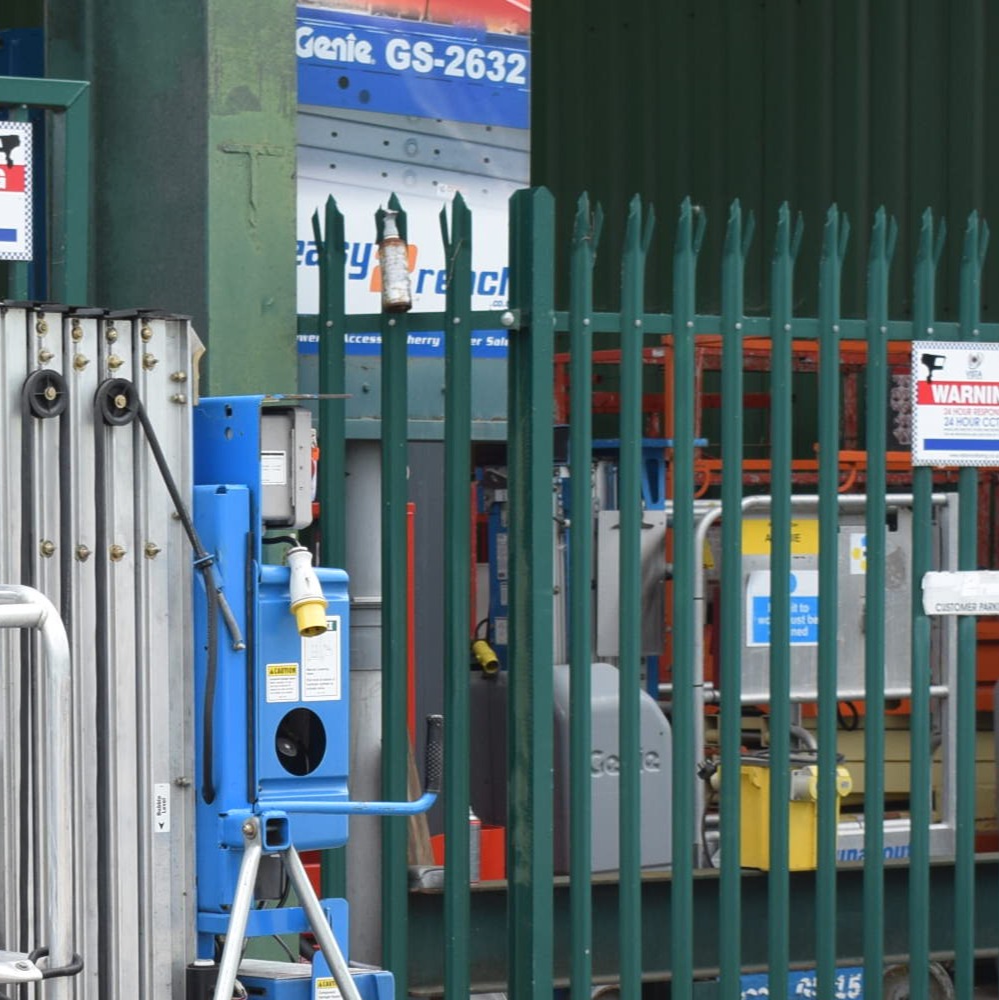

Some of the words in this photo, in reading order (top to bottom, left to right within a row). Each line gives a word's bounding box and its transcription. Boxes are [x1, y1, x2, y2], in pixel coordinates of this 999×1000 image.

[295, 26, 373, 65] Genie
[385, 38, 527, 85] GS-2632
[406, 334, 441, 348] herry
[930, 384, 999, 404] WARNIN
[973, 408, 999, 416] RESPO
[944, 417, 954, 426] 24
[956, 417, 981, 427] HOUR
[982, 417, 999, 427] CCT
[935, 602, 977, 612] CUSTOMER
[590, 749, 661, 778] Gee
